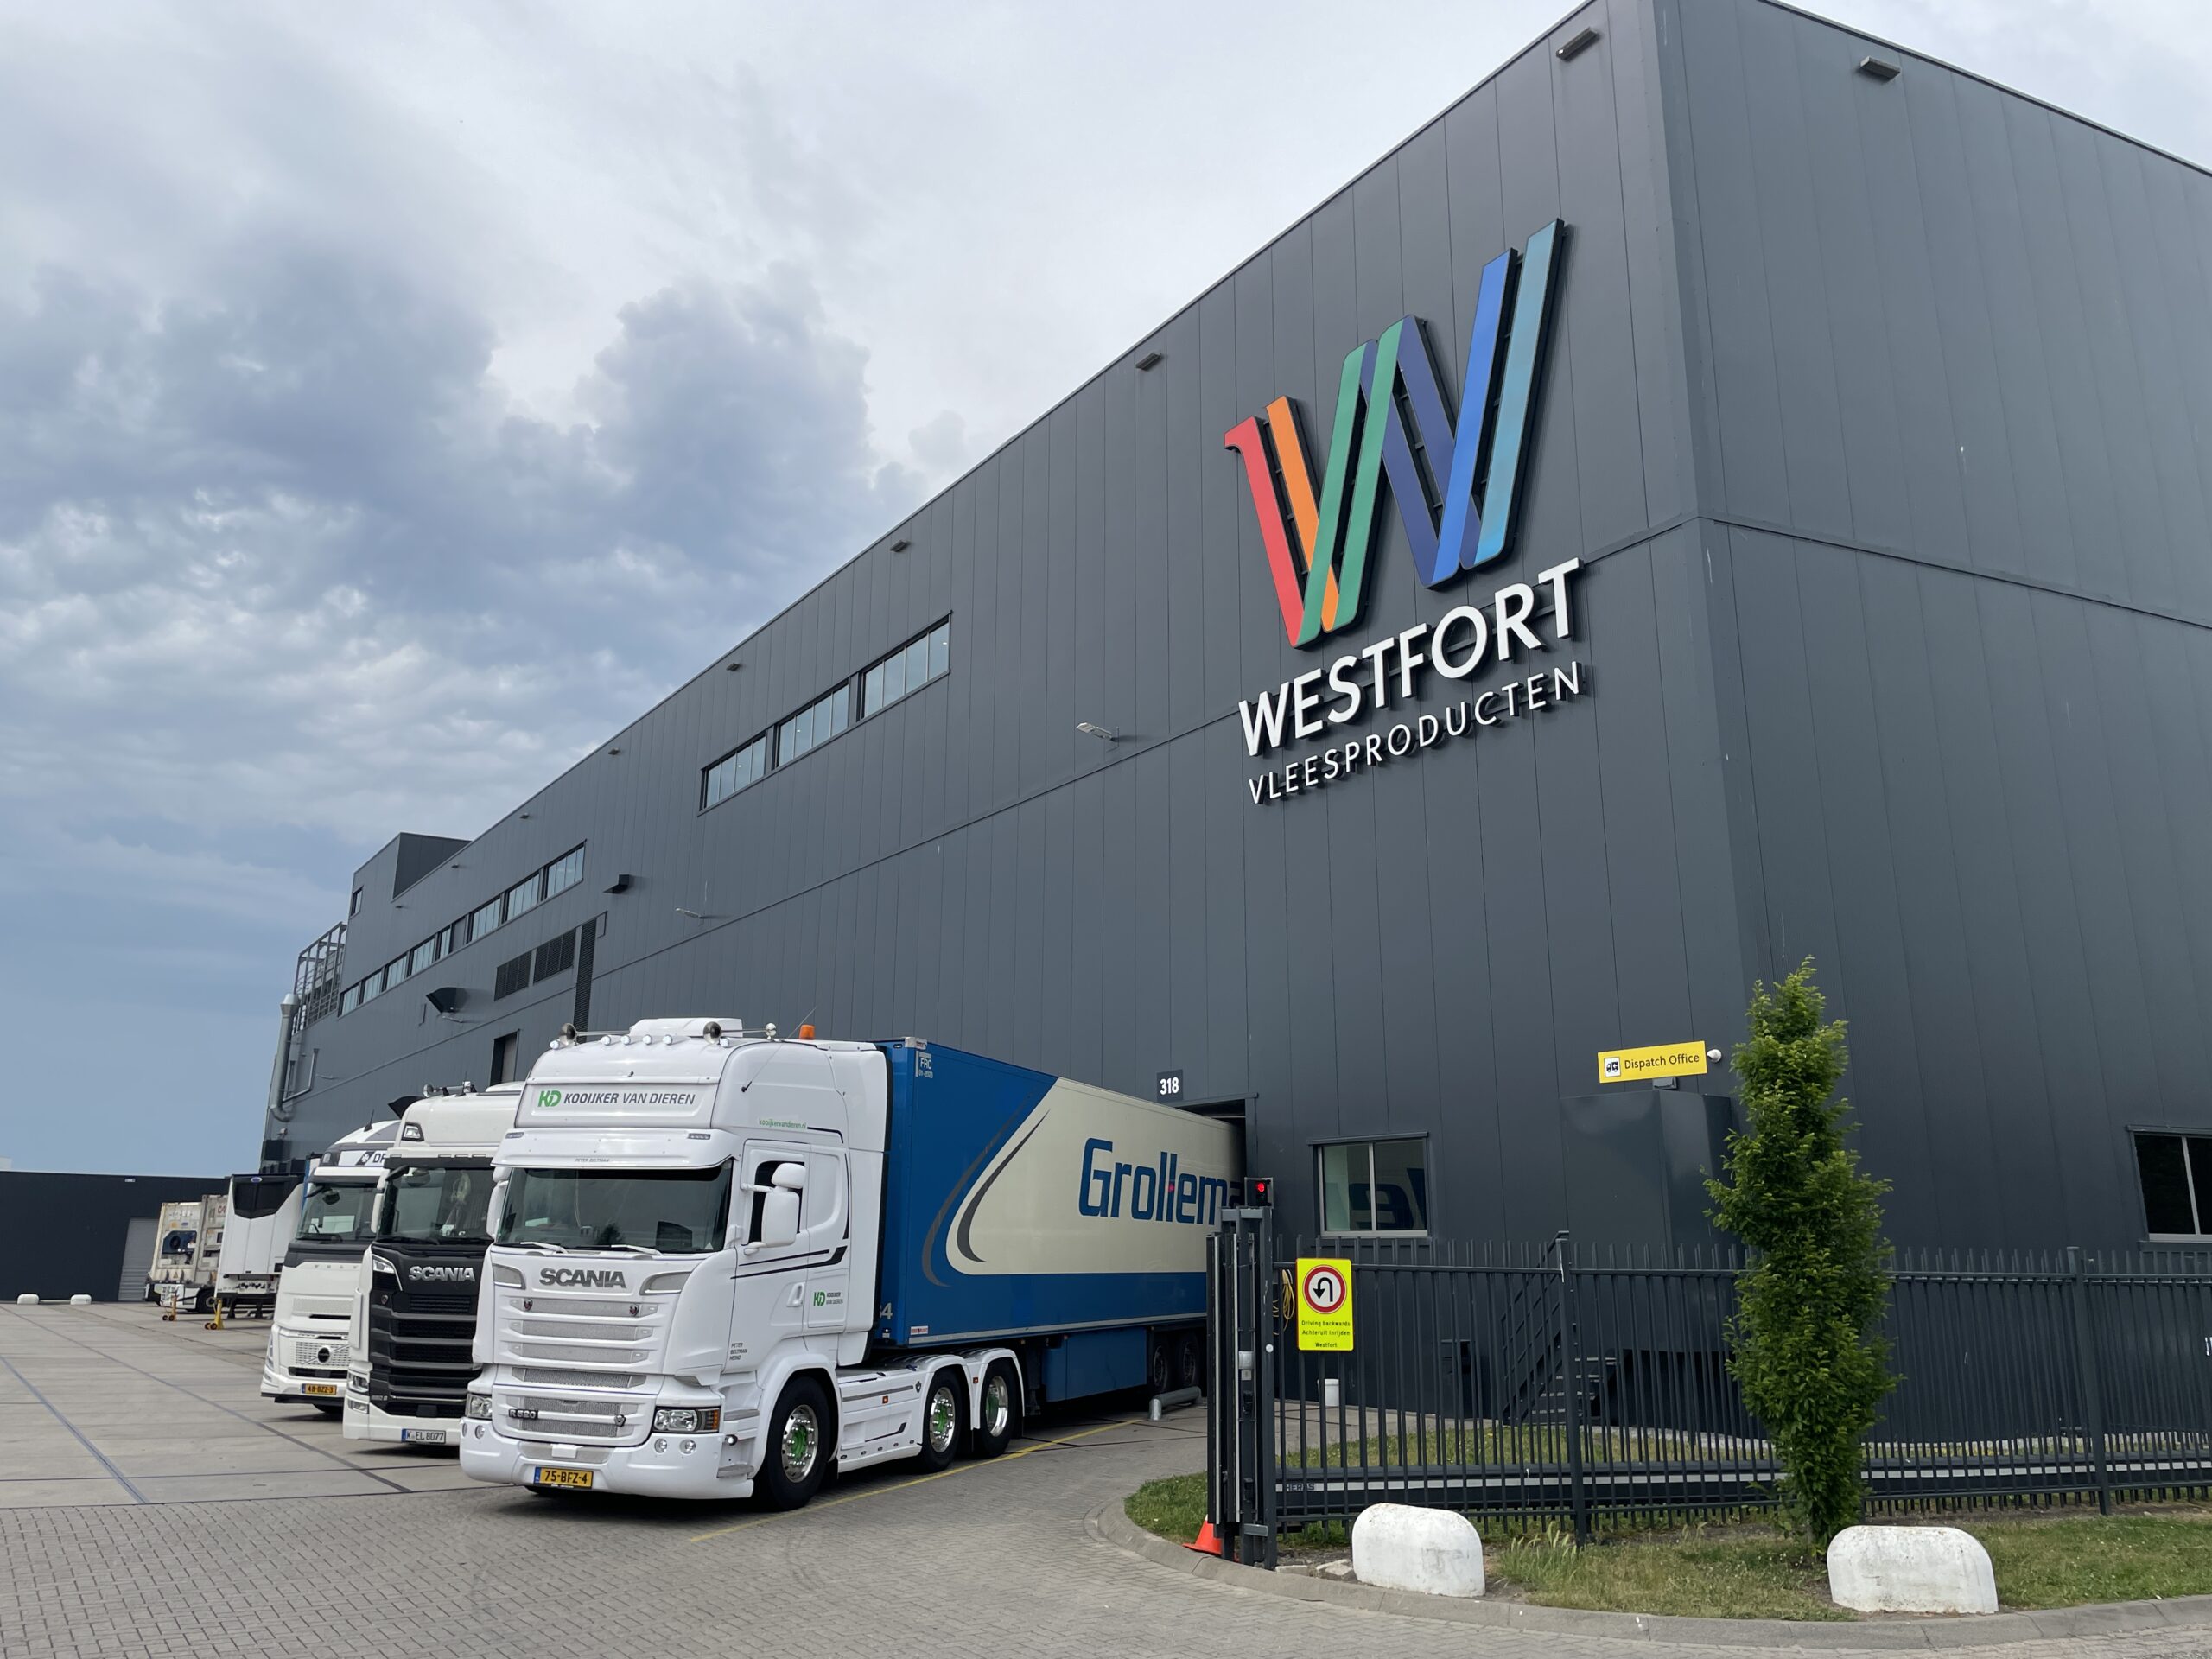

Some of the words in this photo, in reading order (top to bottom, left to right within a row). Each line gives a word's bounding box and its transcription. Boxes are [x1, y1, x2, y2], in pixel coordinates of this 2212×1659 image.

[1238, 557, 1583, 757] WESTFORT
[1249, 660, 1585, 804] VLEESPRODUCTEN
[919, 1058, 932, 1070] FRC
[1624, 1055, 1667, 1071] Dispatch
[1669, 1053, 1700, 1065] Office
[1160, 1077, 1179, 1095] 318
[537, 1090, 562, 1107] KD
[563, 1093, 619, 1104] KOOIJKER
[622, 1093, 648, 1104] VAN
[649, 1093, 696, 1105] DIEREN
[409, 1265, 475, 1282] SCANIA
[539, 1268, 626, 1288] SCANIA
[510, 1409, 517, 1418] R
[517, 1409, 536, 1419] 520
[544, 1470, 588, 1484] 75-BFZ-4
[1286, 1483, 1315, 1491] HERS
